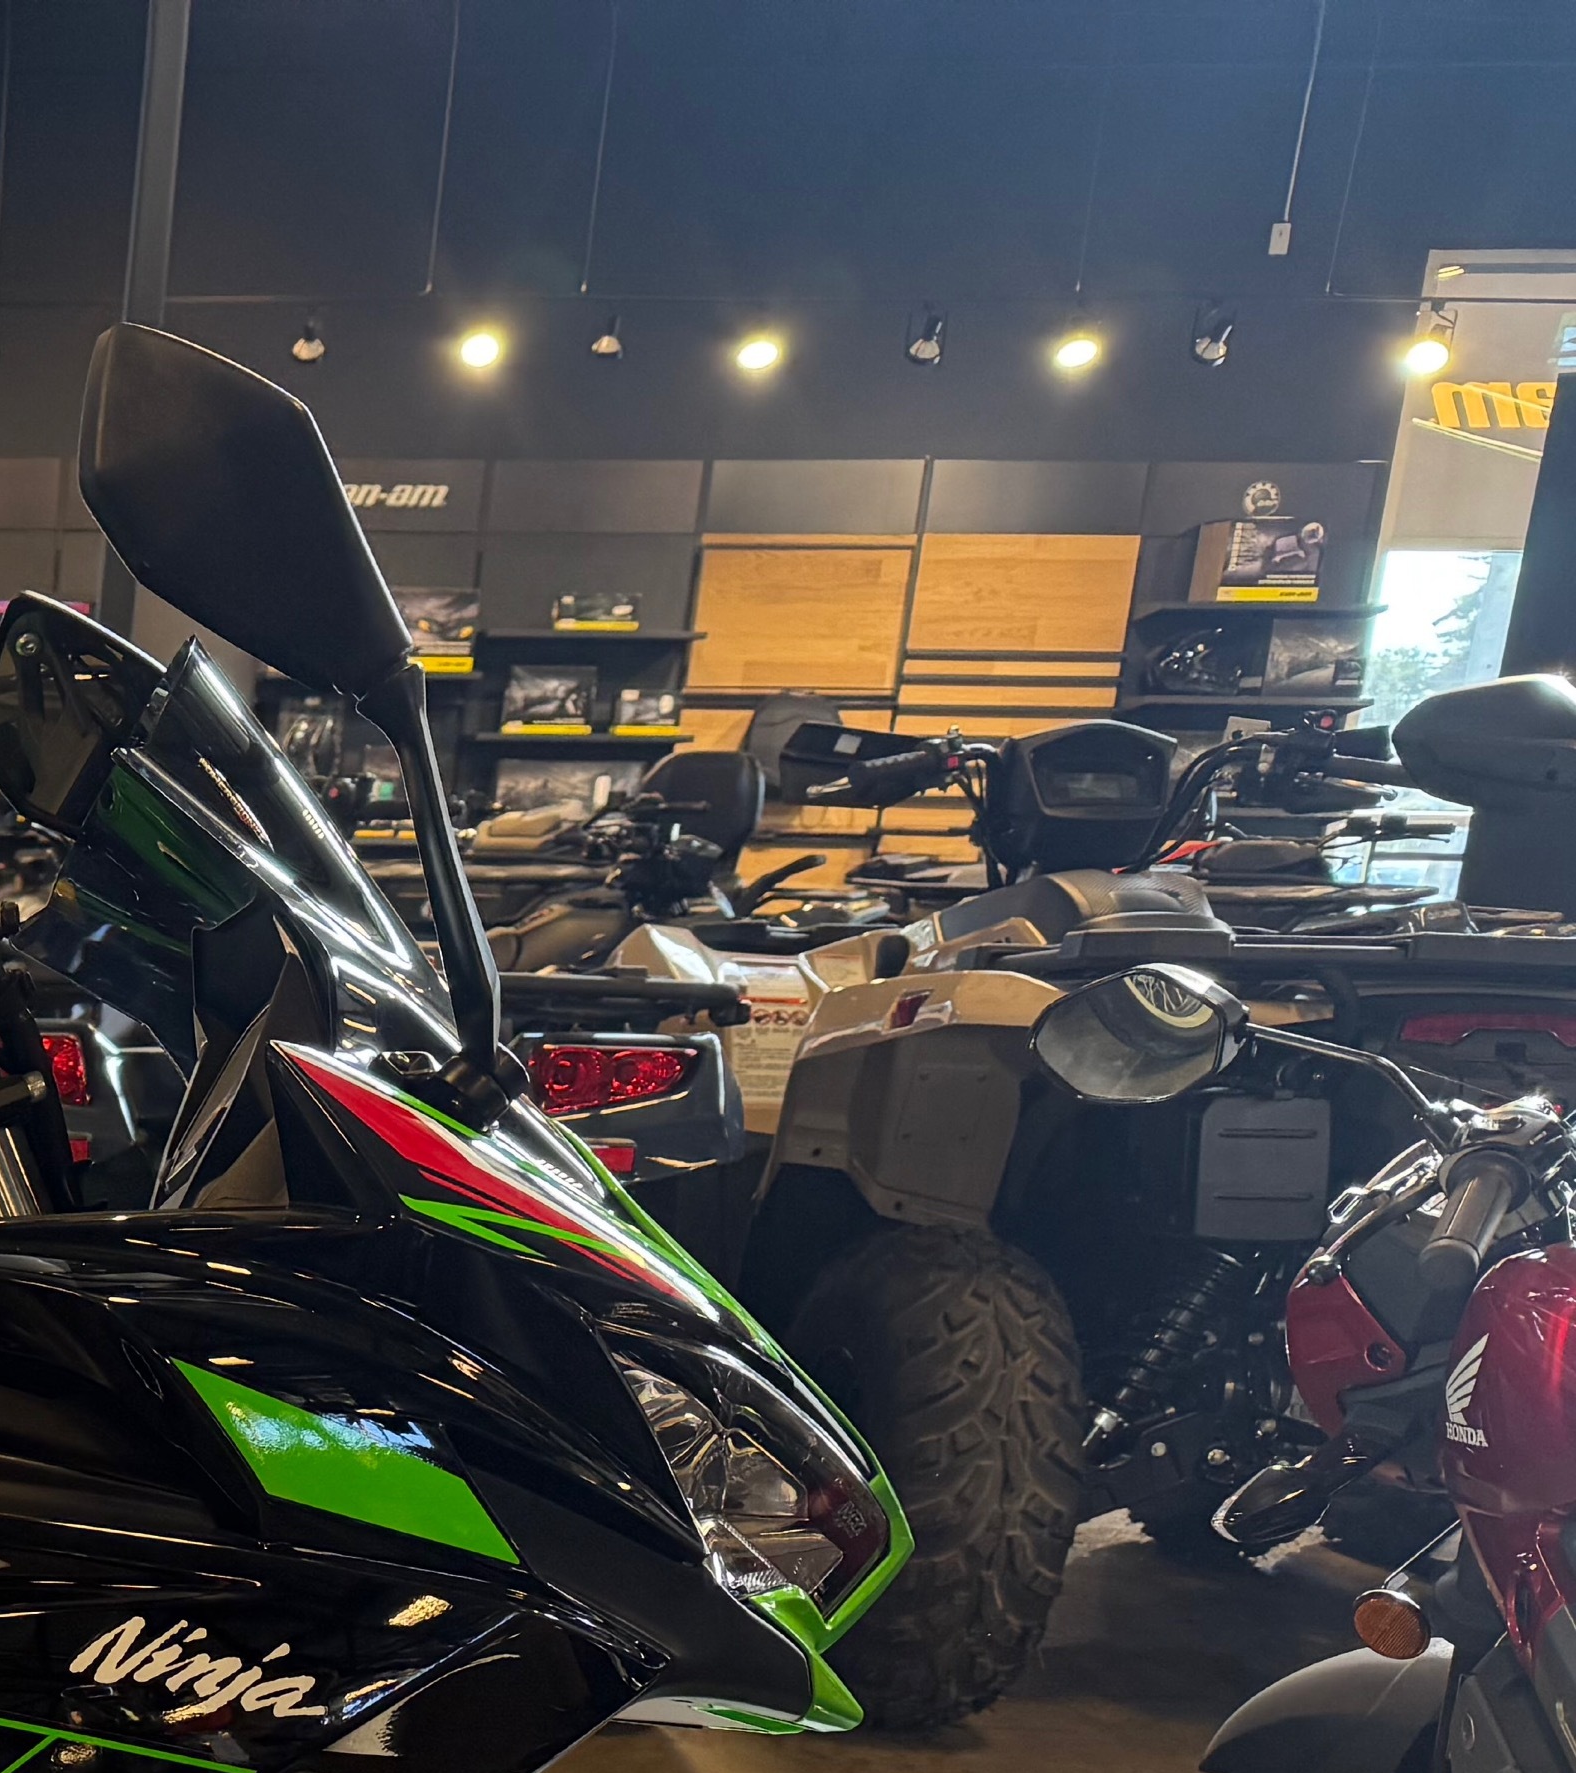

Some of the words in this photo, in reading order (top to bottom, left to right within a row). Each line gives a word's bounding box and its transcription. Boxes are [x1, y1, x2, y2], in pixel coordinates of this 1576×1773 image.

[343, 482, 449, 507] an-am
[1445, 1421, 1489, 1448] HONDA
[68, 1615, 329, 1725] Ninja
